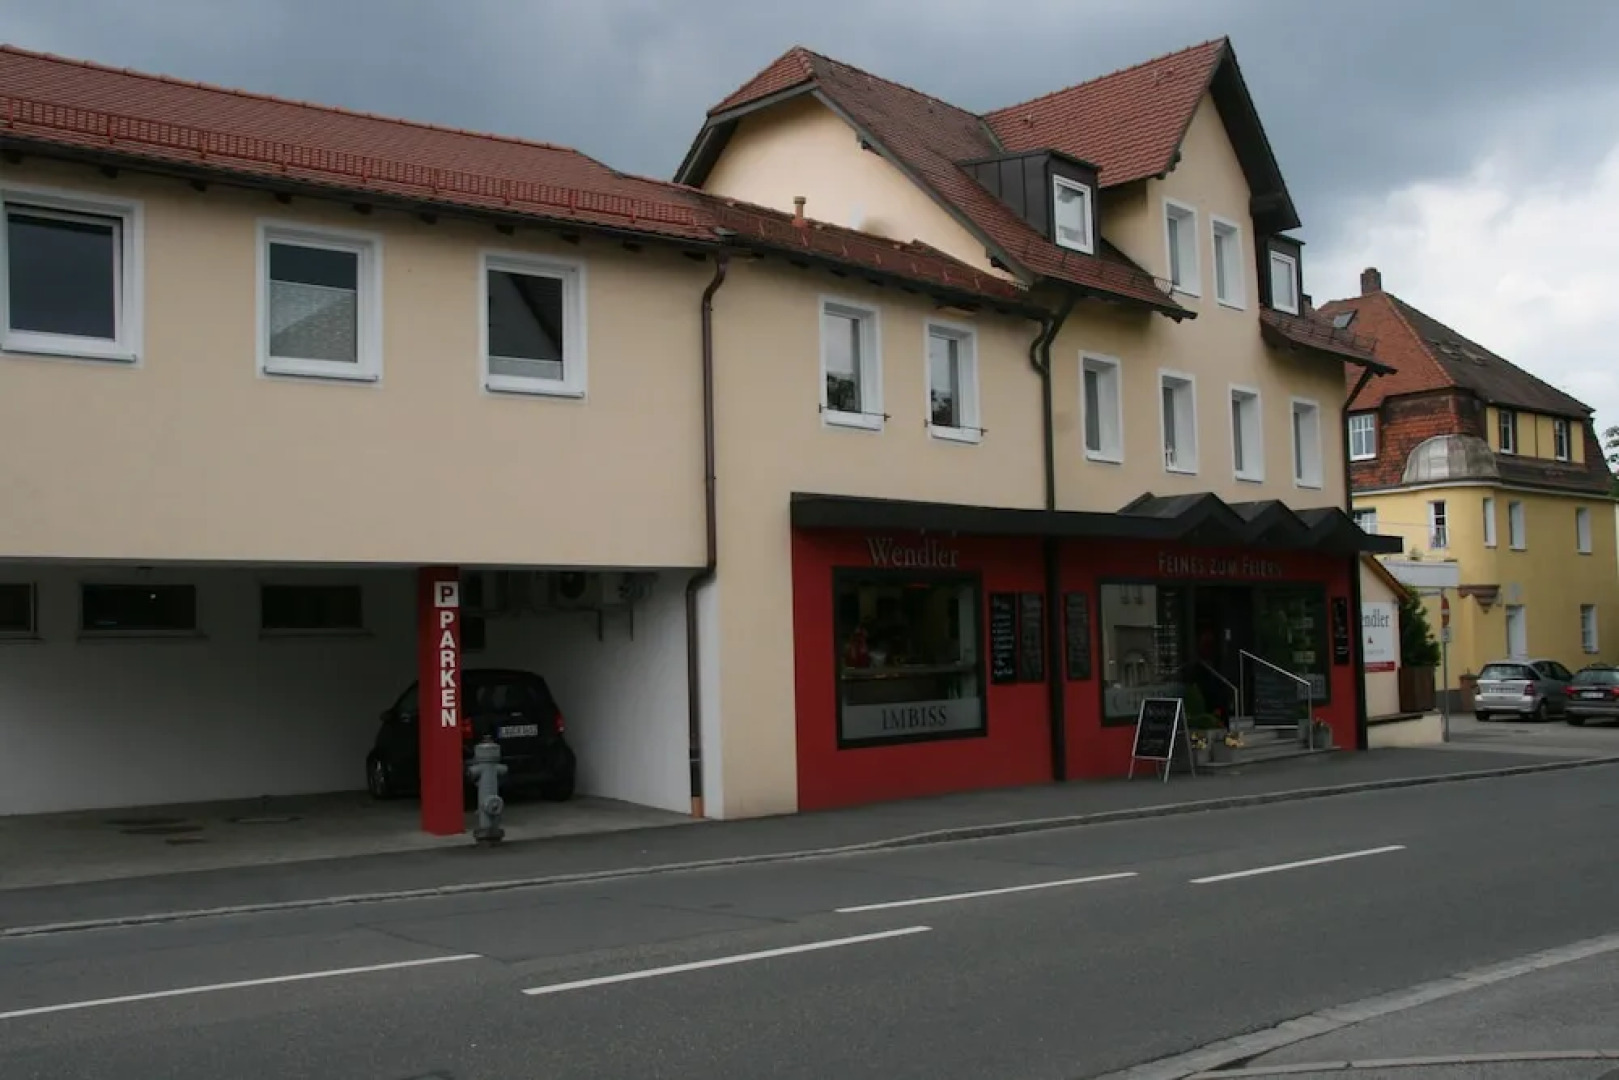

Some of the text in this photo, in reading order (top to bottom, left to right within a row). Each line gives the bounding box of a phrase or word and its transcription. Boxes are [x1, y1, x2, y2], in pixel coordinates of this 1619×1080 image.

[866, 536, 960, 568] Wendler
[440, 587, 454, 603] P
[439, 610, 457, 728] PARKEN
[881, 706, 948, 731] IMBISS
